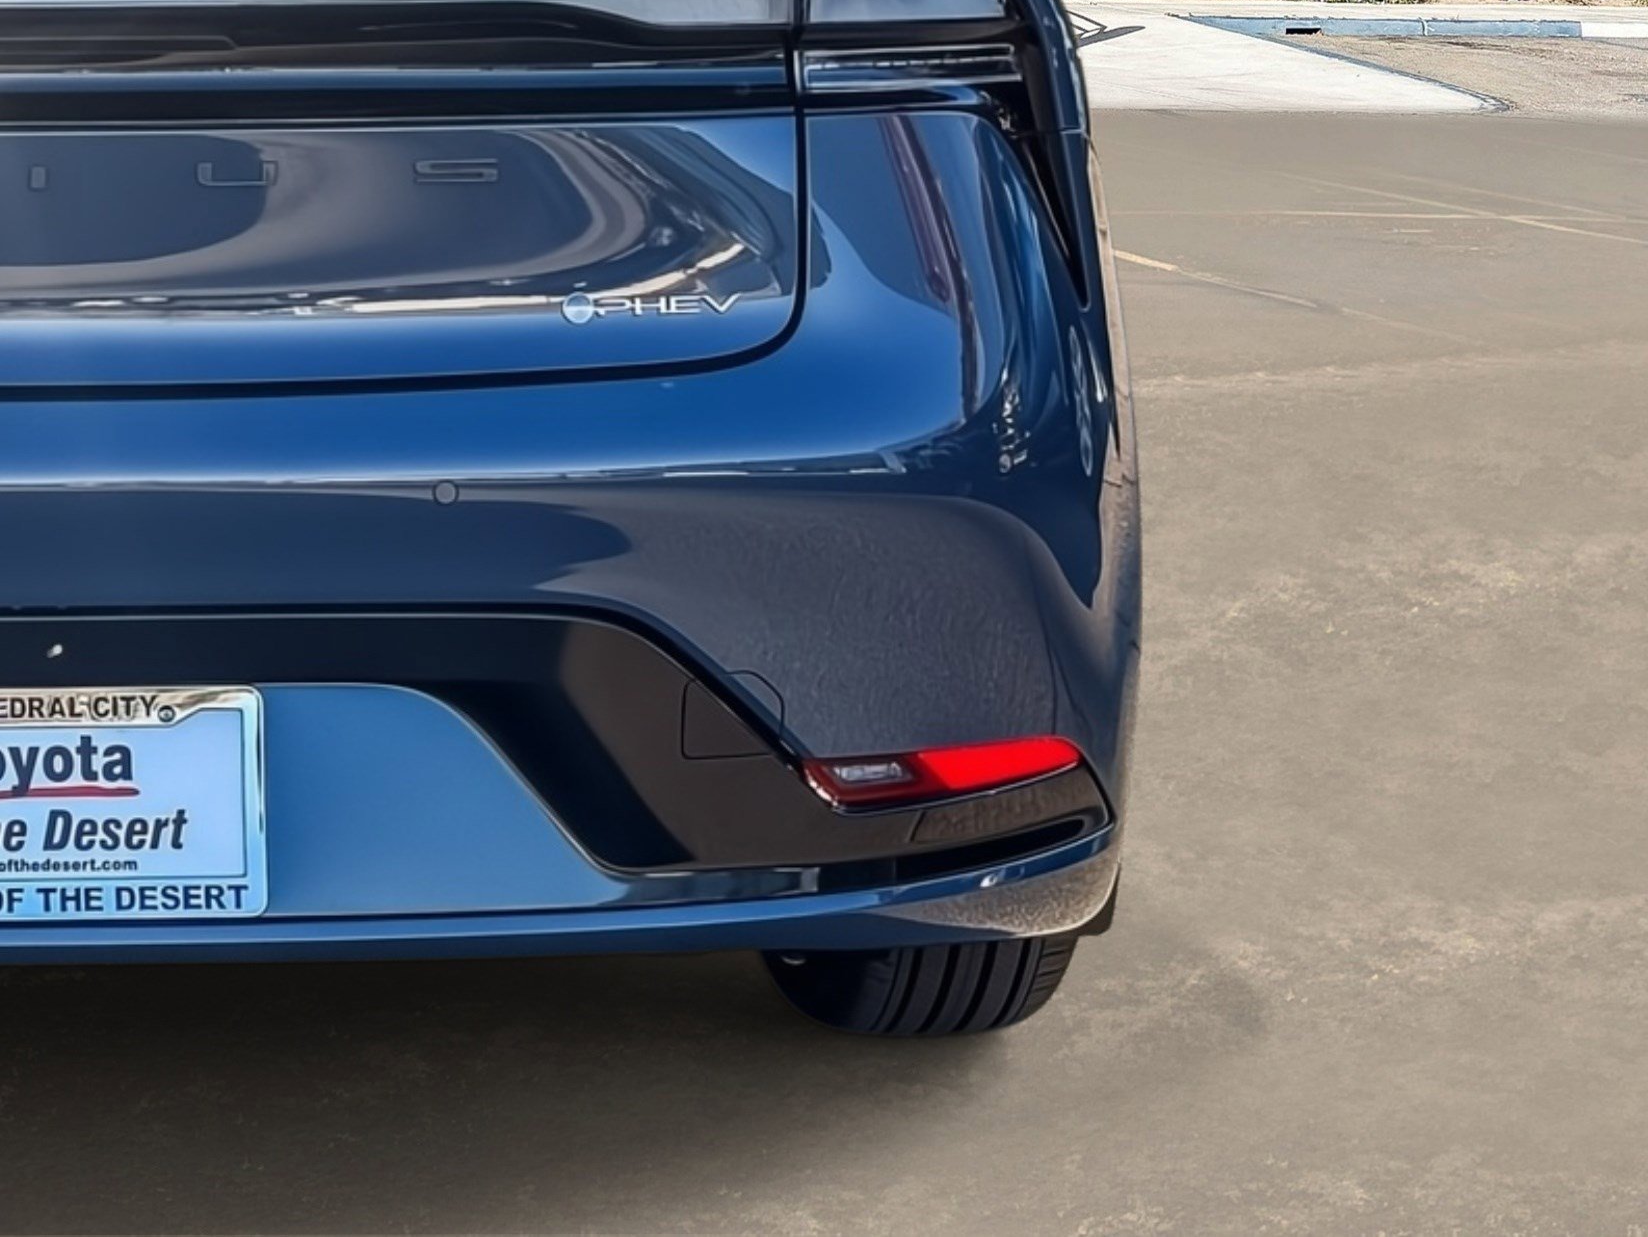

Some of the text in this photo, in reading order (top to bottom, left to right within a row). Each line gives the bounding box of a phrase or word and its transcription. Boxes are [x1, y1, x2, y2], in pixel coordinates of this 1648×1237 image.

[594, 293, 742, 316] PHEV
[92, 695, 158, 718] CITY
[43, 809, 188, 852] Desert
[36, 887, 104, 912] THE
[115, 884, 249, 911] DESERT
